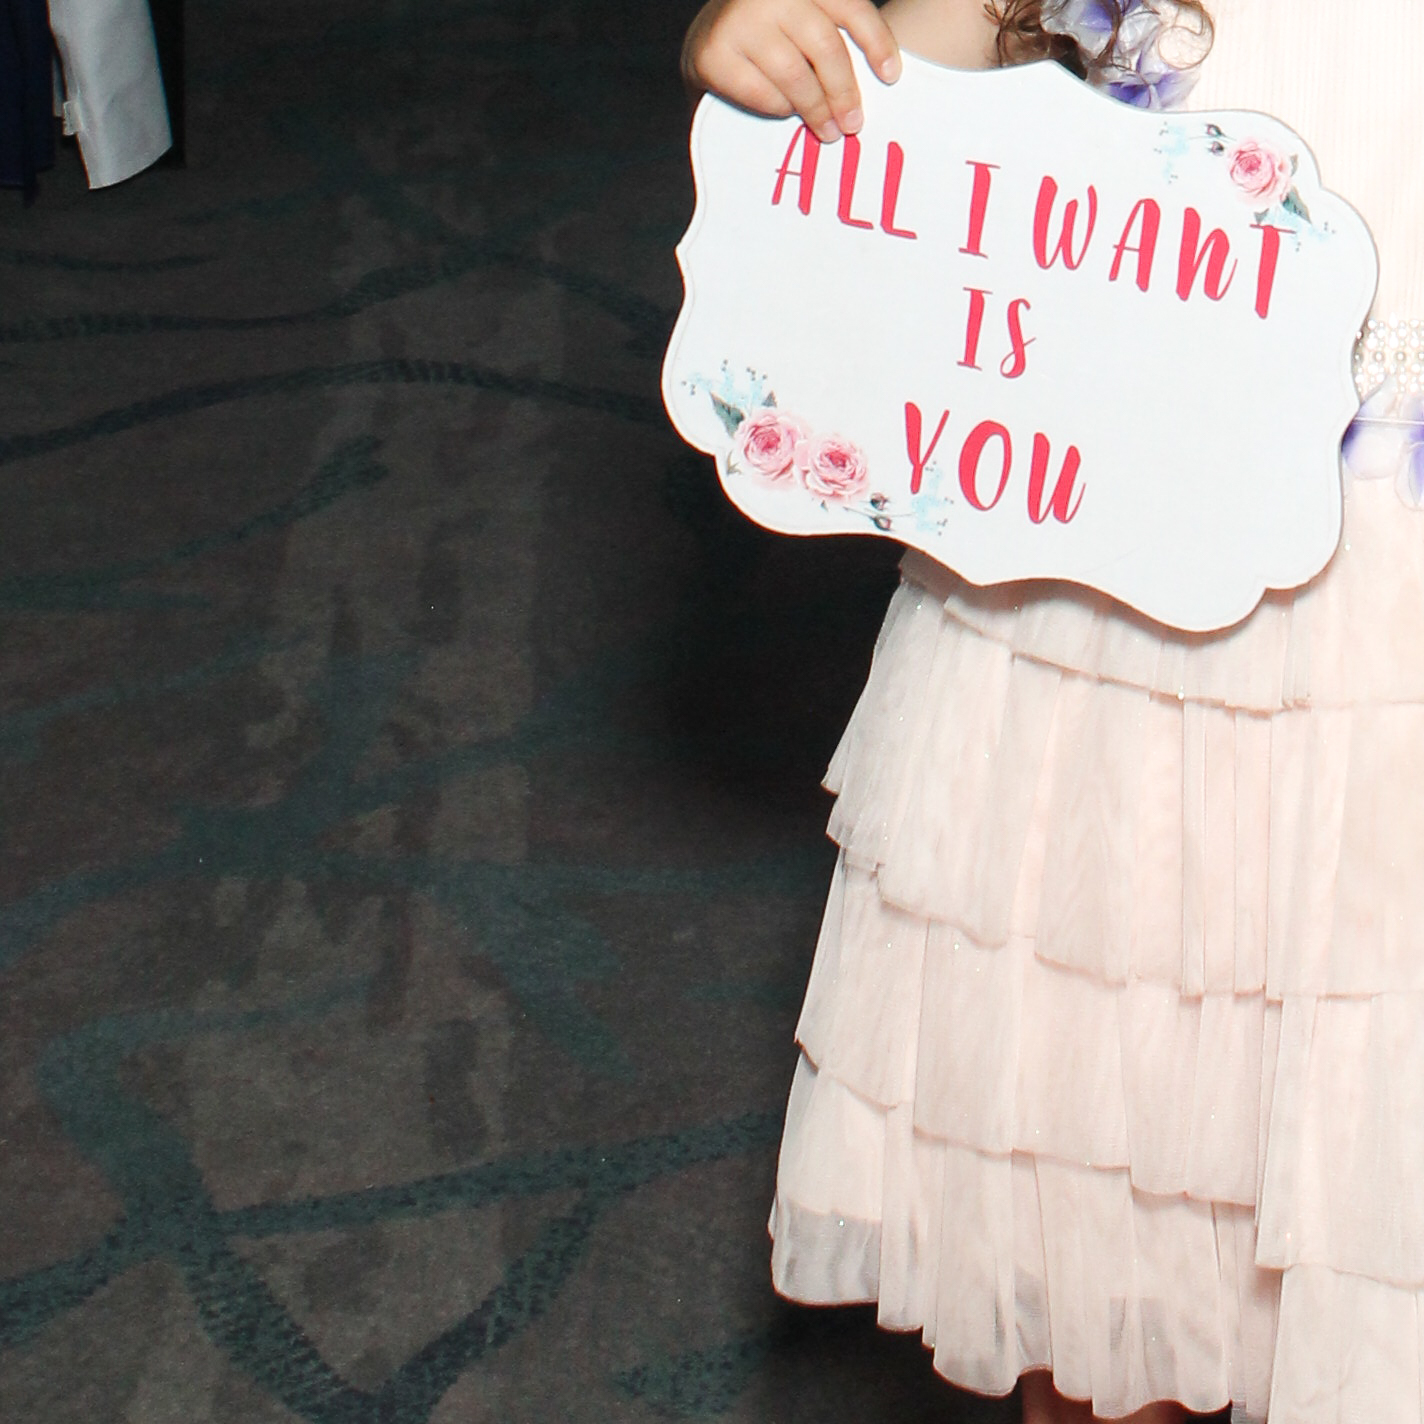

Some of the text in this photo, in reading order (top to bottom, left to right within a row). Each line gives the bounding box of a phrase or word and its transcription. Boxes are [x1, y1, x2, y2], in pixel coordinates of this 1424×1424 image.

[772, 124, 1297, 319] ALL I WANT
[957, 287, 1037, 378] IS
[904, 401, 1086, 524] YOU
